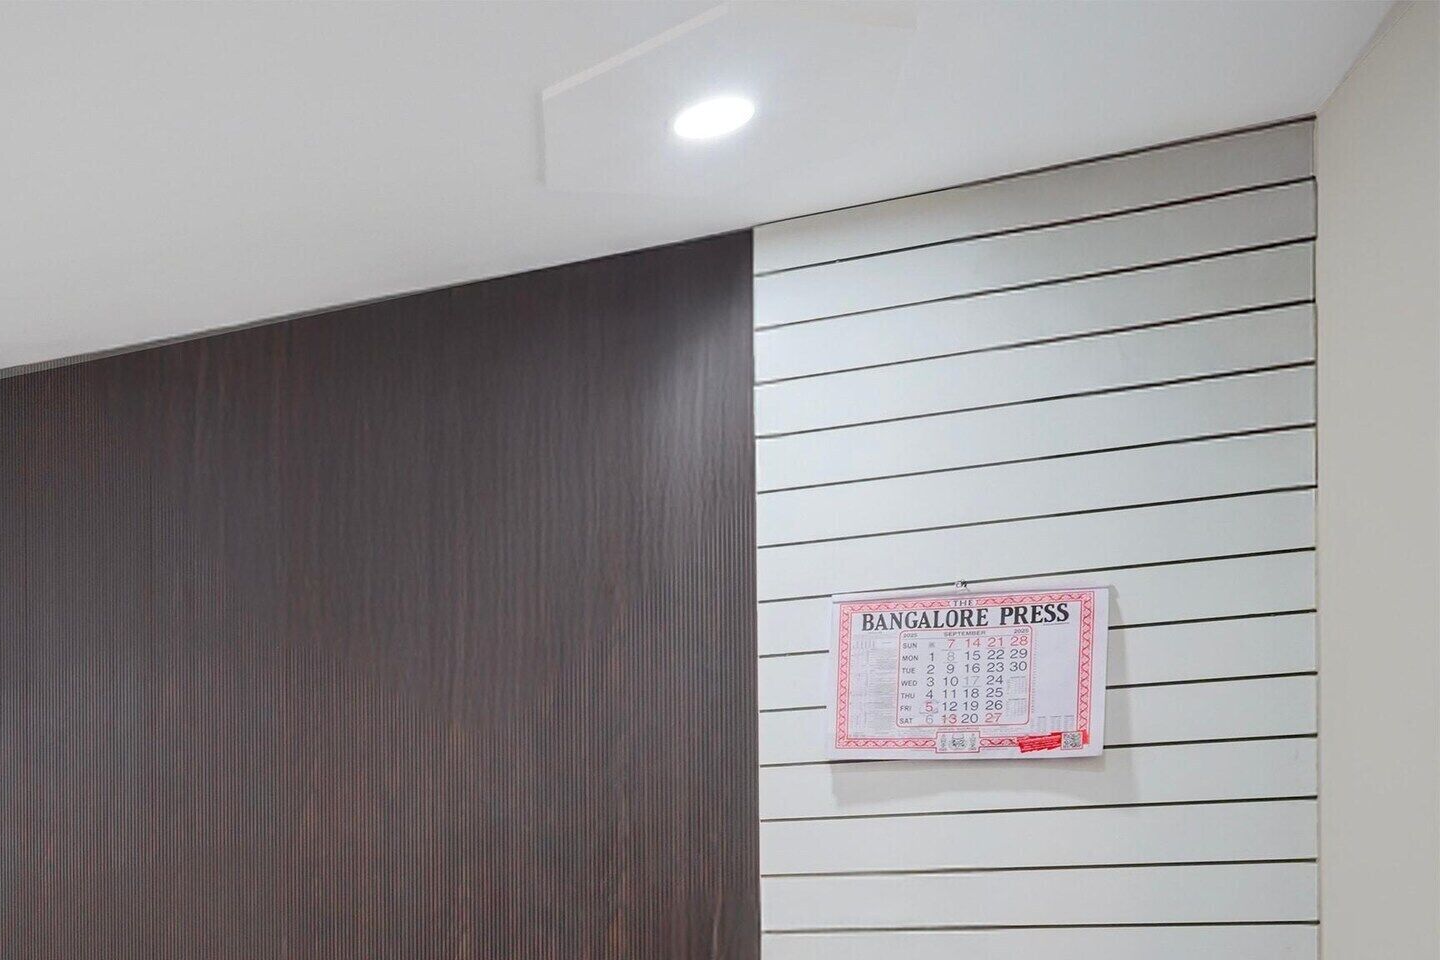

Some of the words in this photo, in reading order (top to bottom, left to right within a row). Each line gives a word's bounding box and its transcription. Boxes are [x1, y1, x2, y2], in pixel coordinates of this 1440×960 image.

[862, 608, 988, 632] BANGALORE
[1000, 603, 1070, 625] PRESS
[948, 640, 955, 648] 7
[966, 638, 980, 647] 14
[988, 638, 1003, 647] 21
[1010, 636, 1028, 646] 28
[930, 652, 934, 661] 1
[947, 652, 955, 660] 8
[965, 651, 980, 660] 15
[987, 650, 1004, 659] 22
[1010, 648, 1028, 659] 29
[927, 664, 935, 674] 2
[946, 664, 954, 674] 9
[965, 664, 980, 673] 16
[987, 662, 1004, 672] 23
[1010, 661, 1027, 671] 30
[926, 677, 934, 687] 3
[944, 676, 958, 686] 10
[962, 676, 980, 686] 17
[986, 675, 1003, 685] 24
[926, 690, 933, 699] 4
[942, 689, 956, 698] 11
[964, 689, 979, 698] 18
[986, 688, 1003, 698] 25
[925, 701, 933, 712] 5
[942, 702, 958, 711] 12
[964, 701, 979, 710] 19
[985, 700, 1003, 710] 26
[925, 715, 934, 724] 6
[942, 714, 957, 724] 13
[961, 714, 978, 723] 20
[985, 713, 1002, 722] 27
